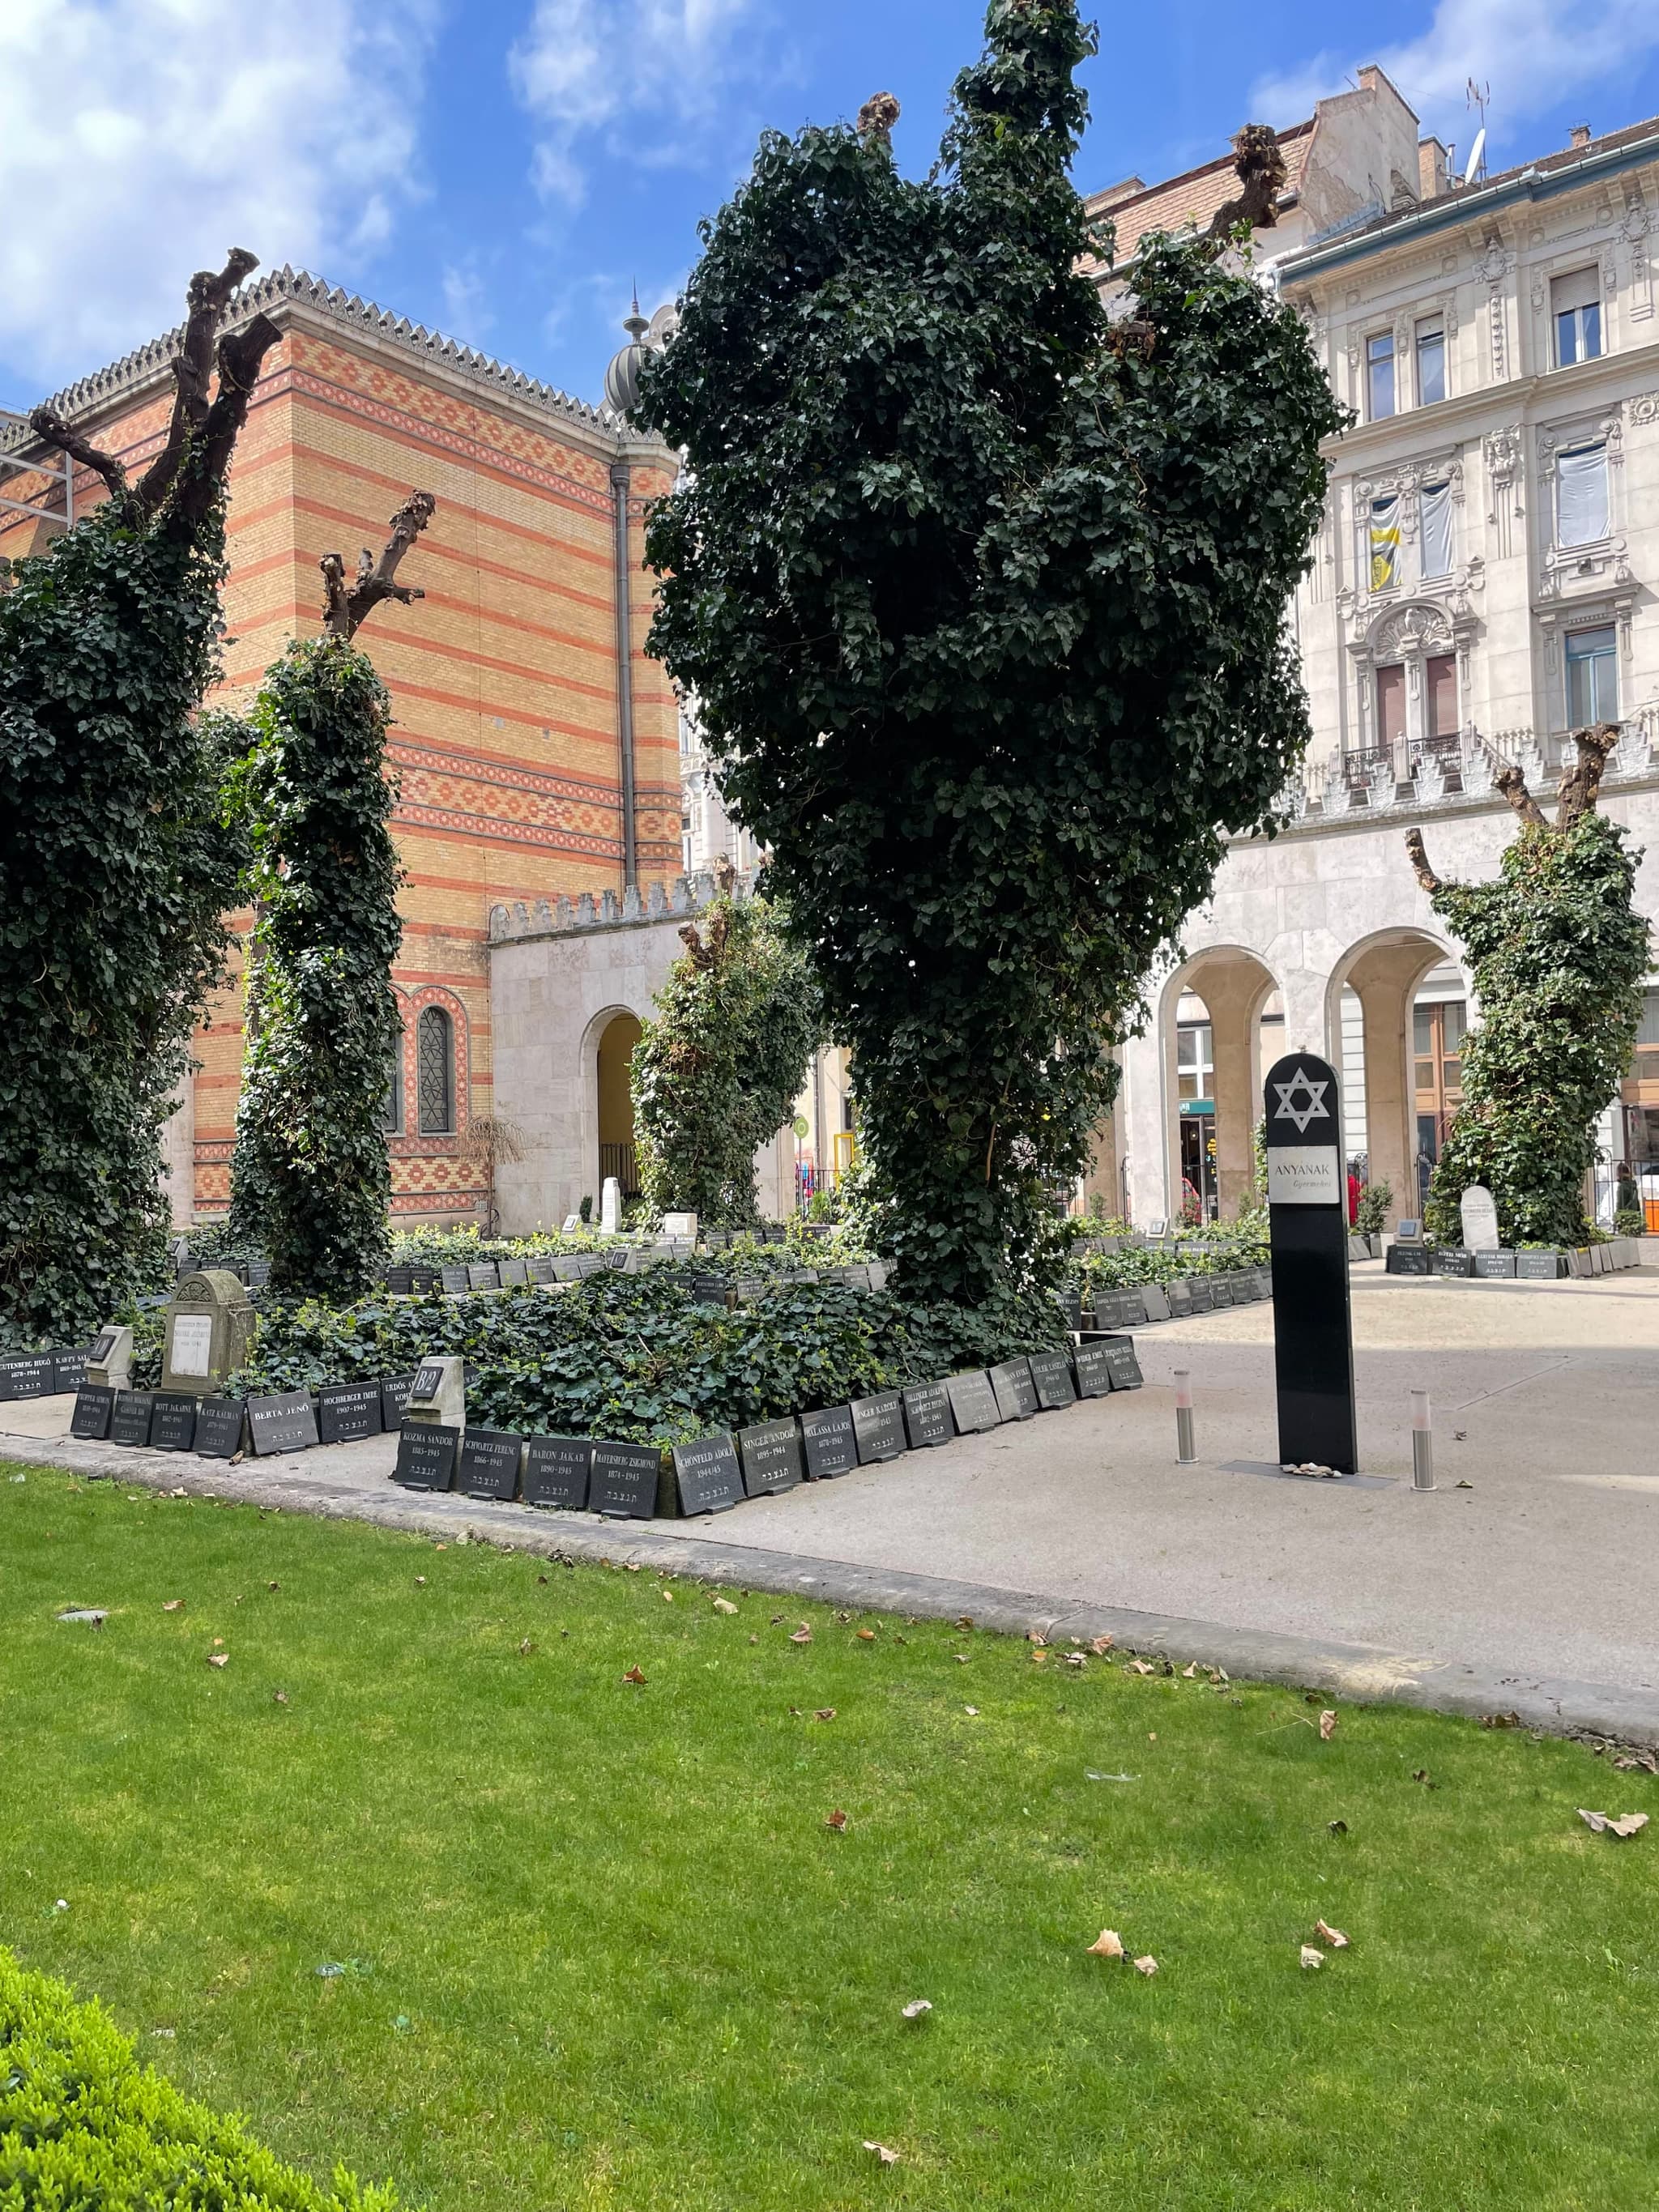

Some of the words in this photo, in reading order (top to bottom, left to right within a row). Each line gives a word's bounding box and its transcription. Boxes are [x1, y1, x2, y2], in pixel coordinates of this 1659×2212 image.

[34, 1358, 51, 1366] HUGÓ
[416, 1370, 437, 1392] B/2
[324, 1392, 361, 1405] HOCHBERGER
[363, 1390, 378, 1400] IMRE
[254, 1411, 283, 1421] BERTA
[285, 1403, 309, 1416] JENŐ
[336, 1404, 367, 1414] 1907-1945
[833, 1421, 851, 1432] LAJOS
[403, 1432, 426, 1443] KOZMA
[427, 1434, 454, 1446] SÁNDOR
[744, 1435, 770, 1450] SINGER
[770, 1429, 795, 1444] ANDOR
[412, 1447, 441, 1457] 1885-1945
[493, 1443, 517, 1455] FERENC
[757, 1446, 786, 1460] 1895-1944
[473, 1455, 503, 1467] 1866-1945
[558, 1451, 584, 1463] JAKAB
[629, 1457, 656, 1469] ZSIGMOND
[540, 1464, 572, 1475] 1890-1945
[697, 1465, 721, 1478] 1944/45
